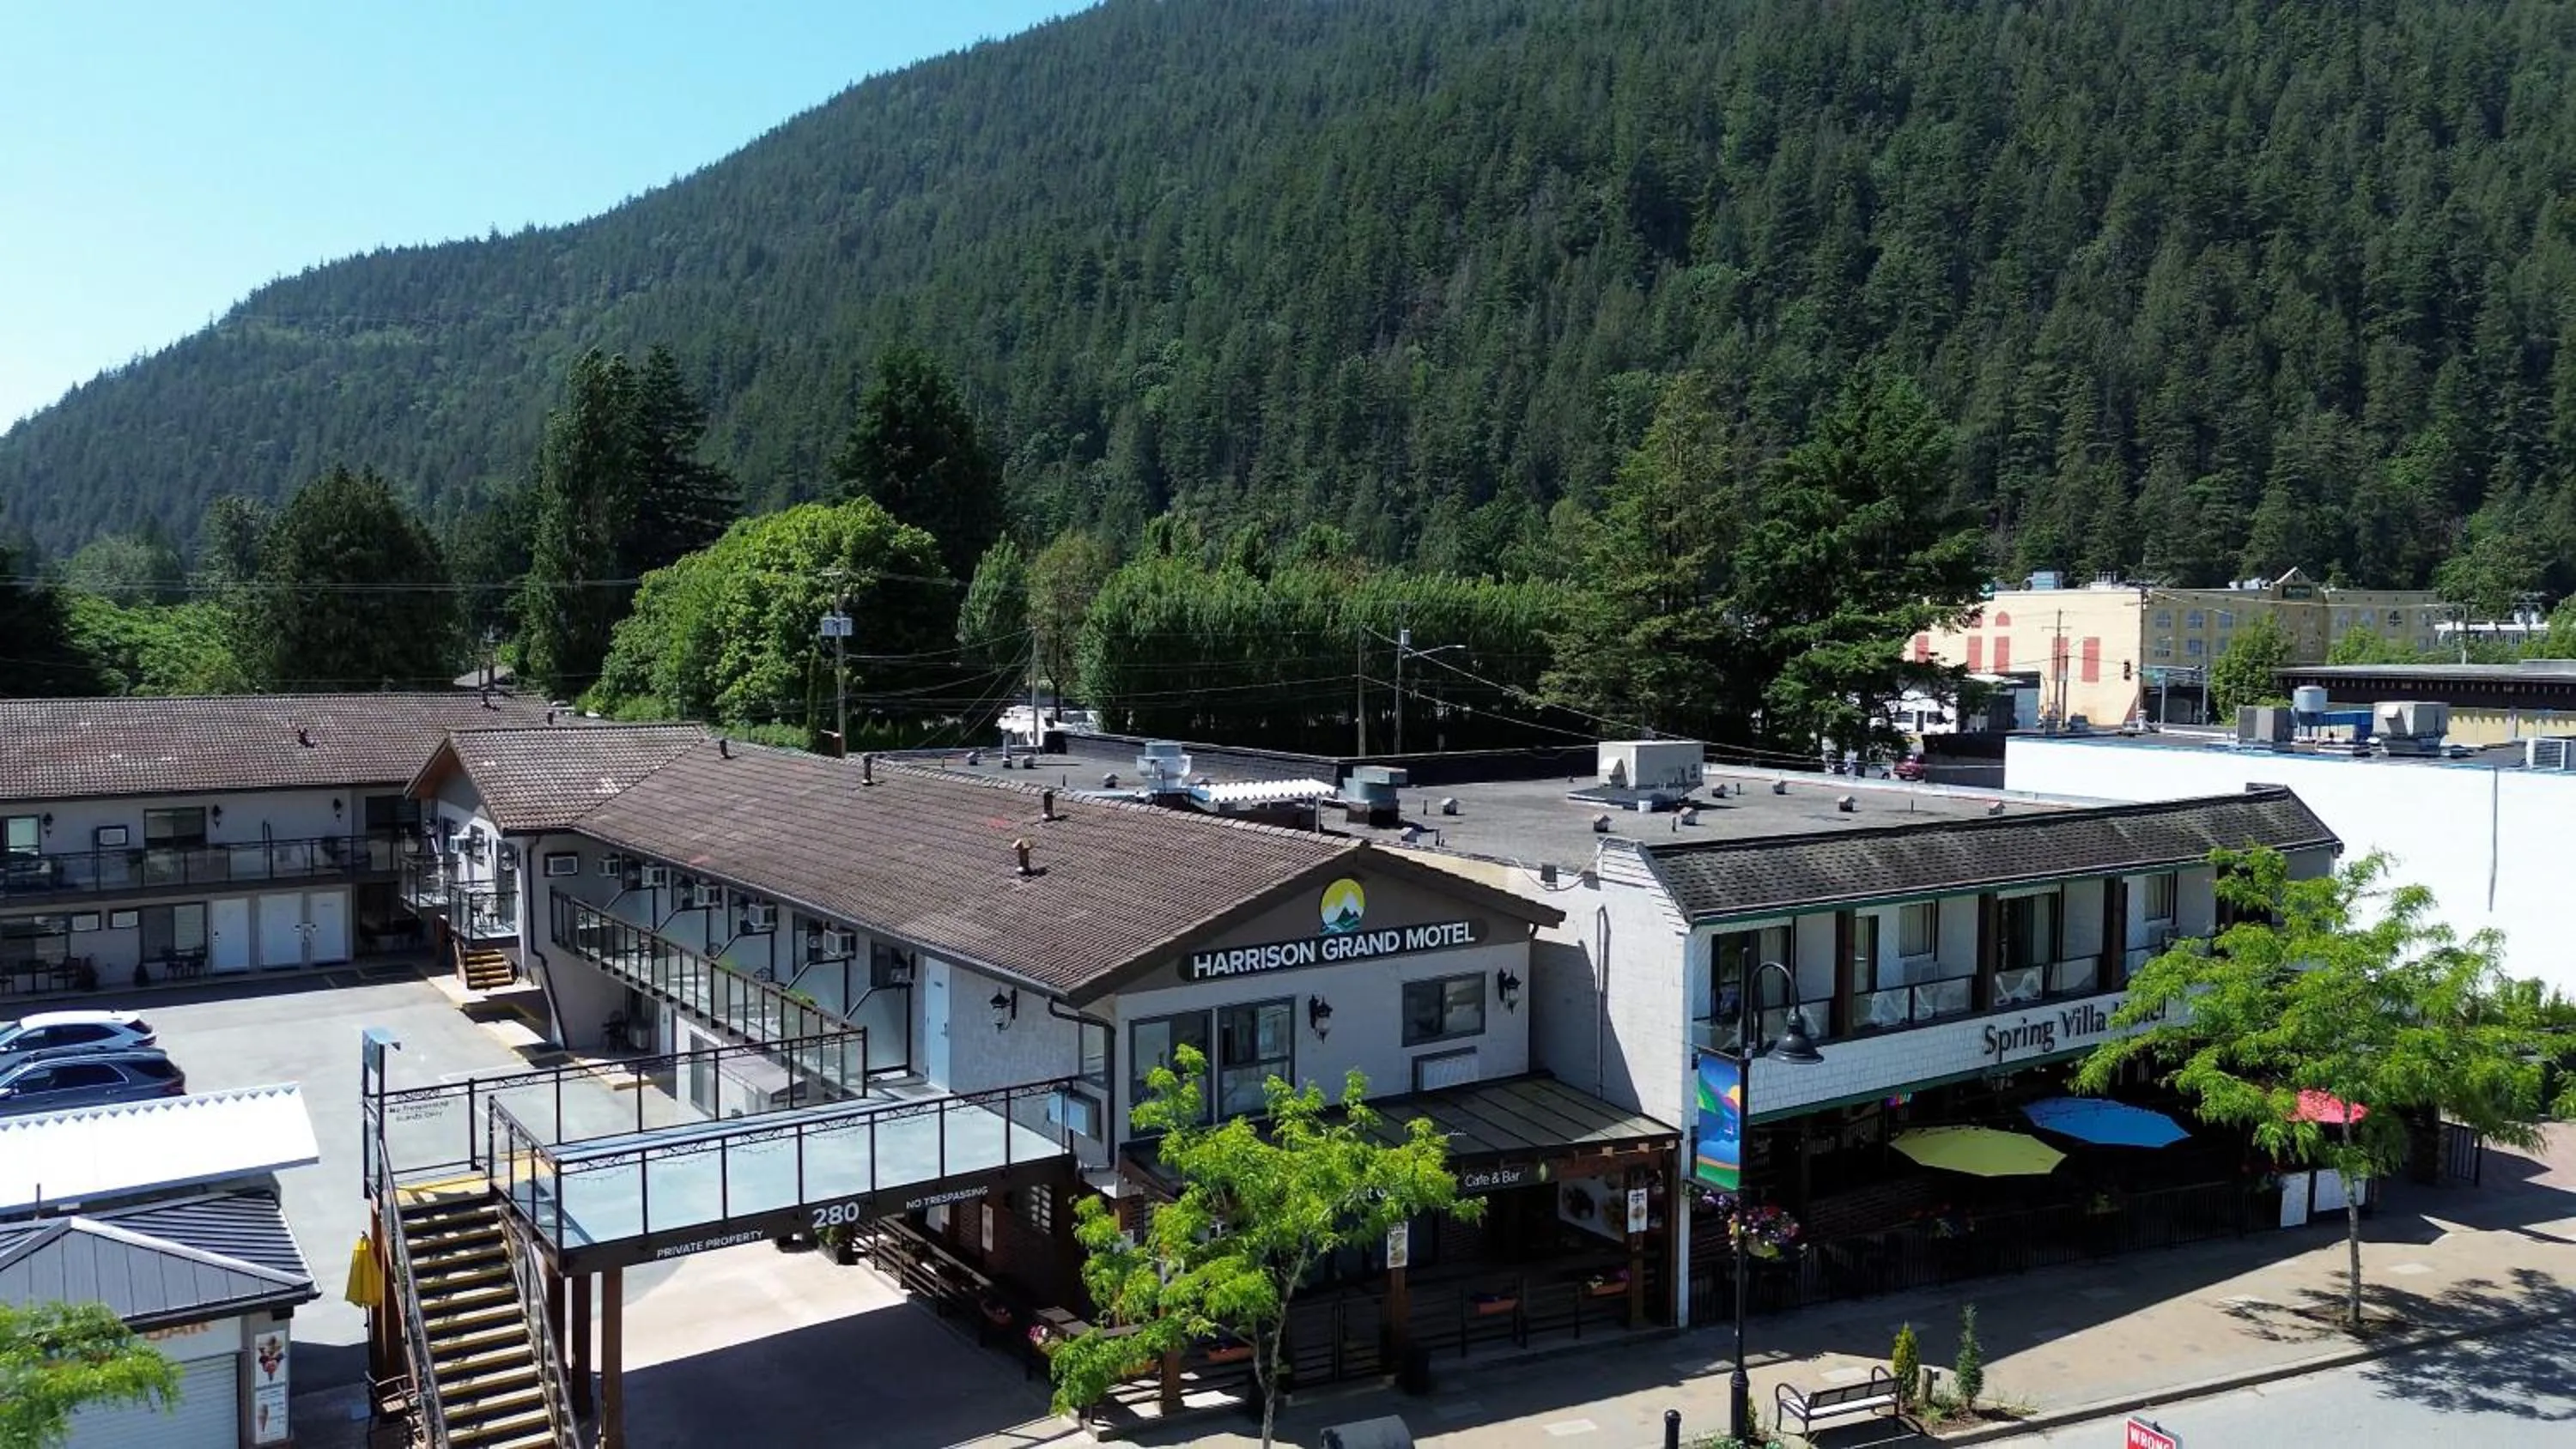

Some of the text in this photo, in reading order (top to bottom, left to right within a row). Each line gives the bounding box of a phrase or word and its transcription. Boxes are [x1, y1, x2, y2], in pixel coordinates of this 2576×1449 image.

[1193, 921, 1475, 979] HARRISON GRAND MOTEL
[1984, 1017, 2056, 1062] Spring
[2059, 1003, 2107, 1038] Villa
[1464, 1169, 1522, 1188] Cafe & Bar
[906, 1185, 988, 1210] NO TRESPASSING
[811, 1202, 860, 1229] 280
[657, 1230, 764, 1258] PRIVATE PROPERTY
